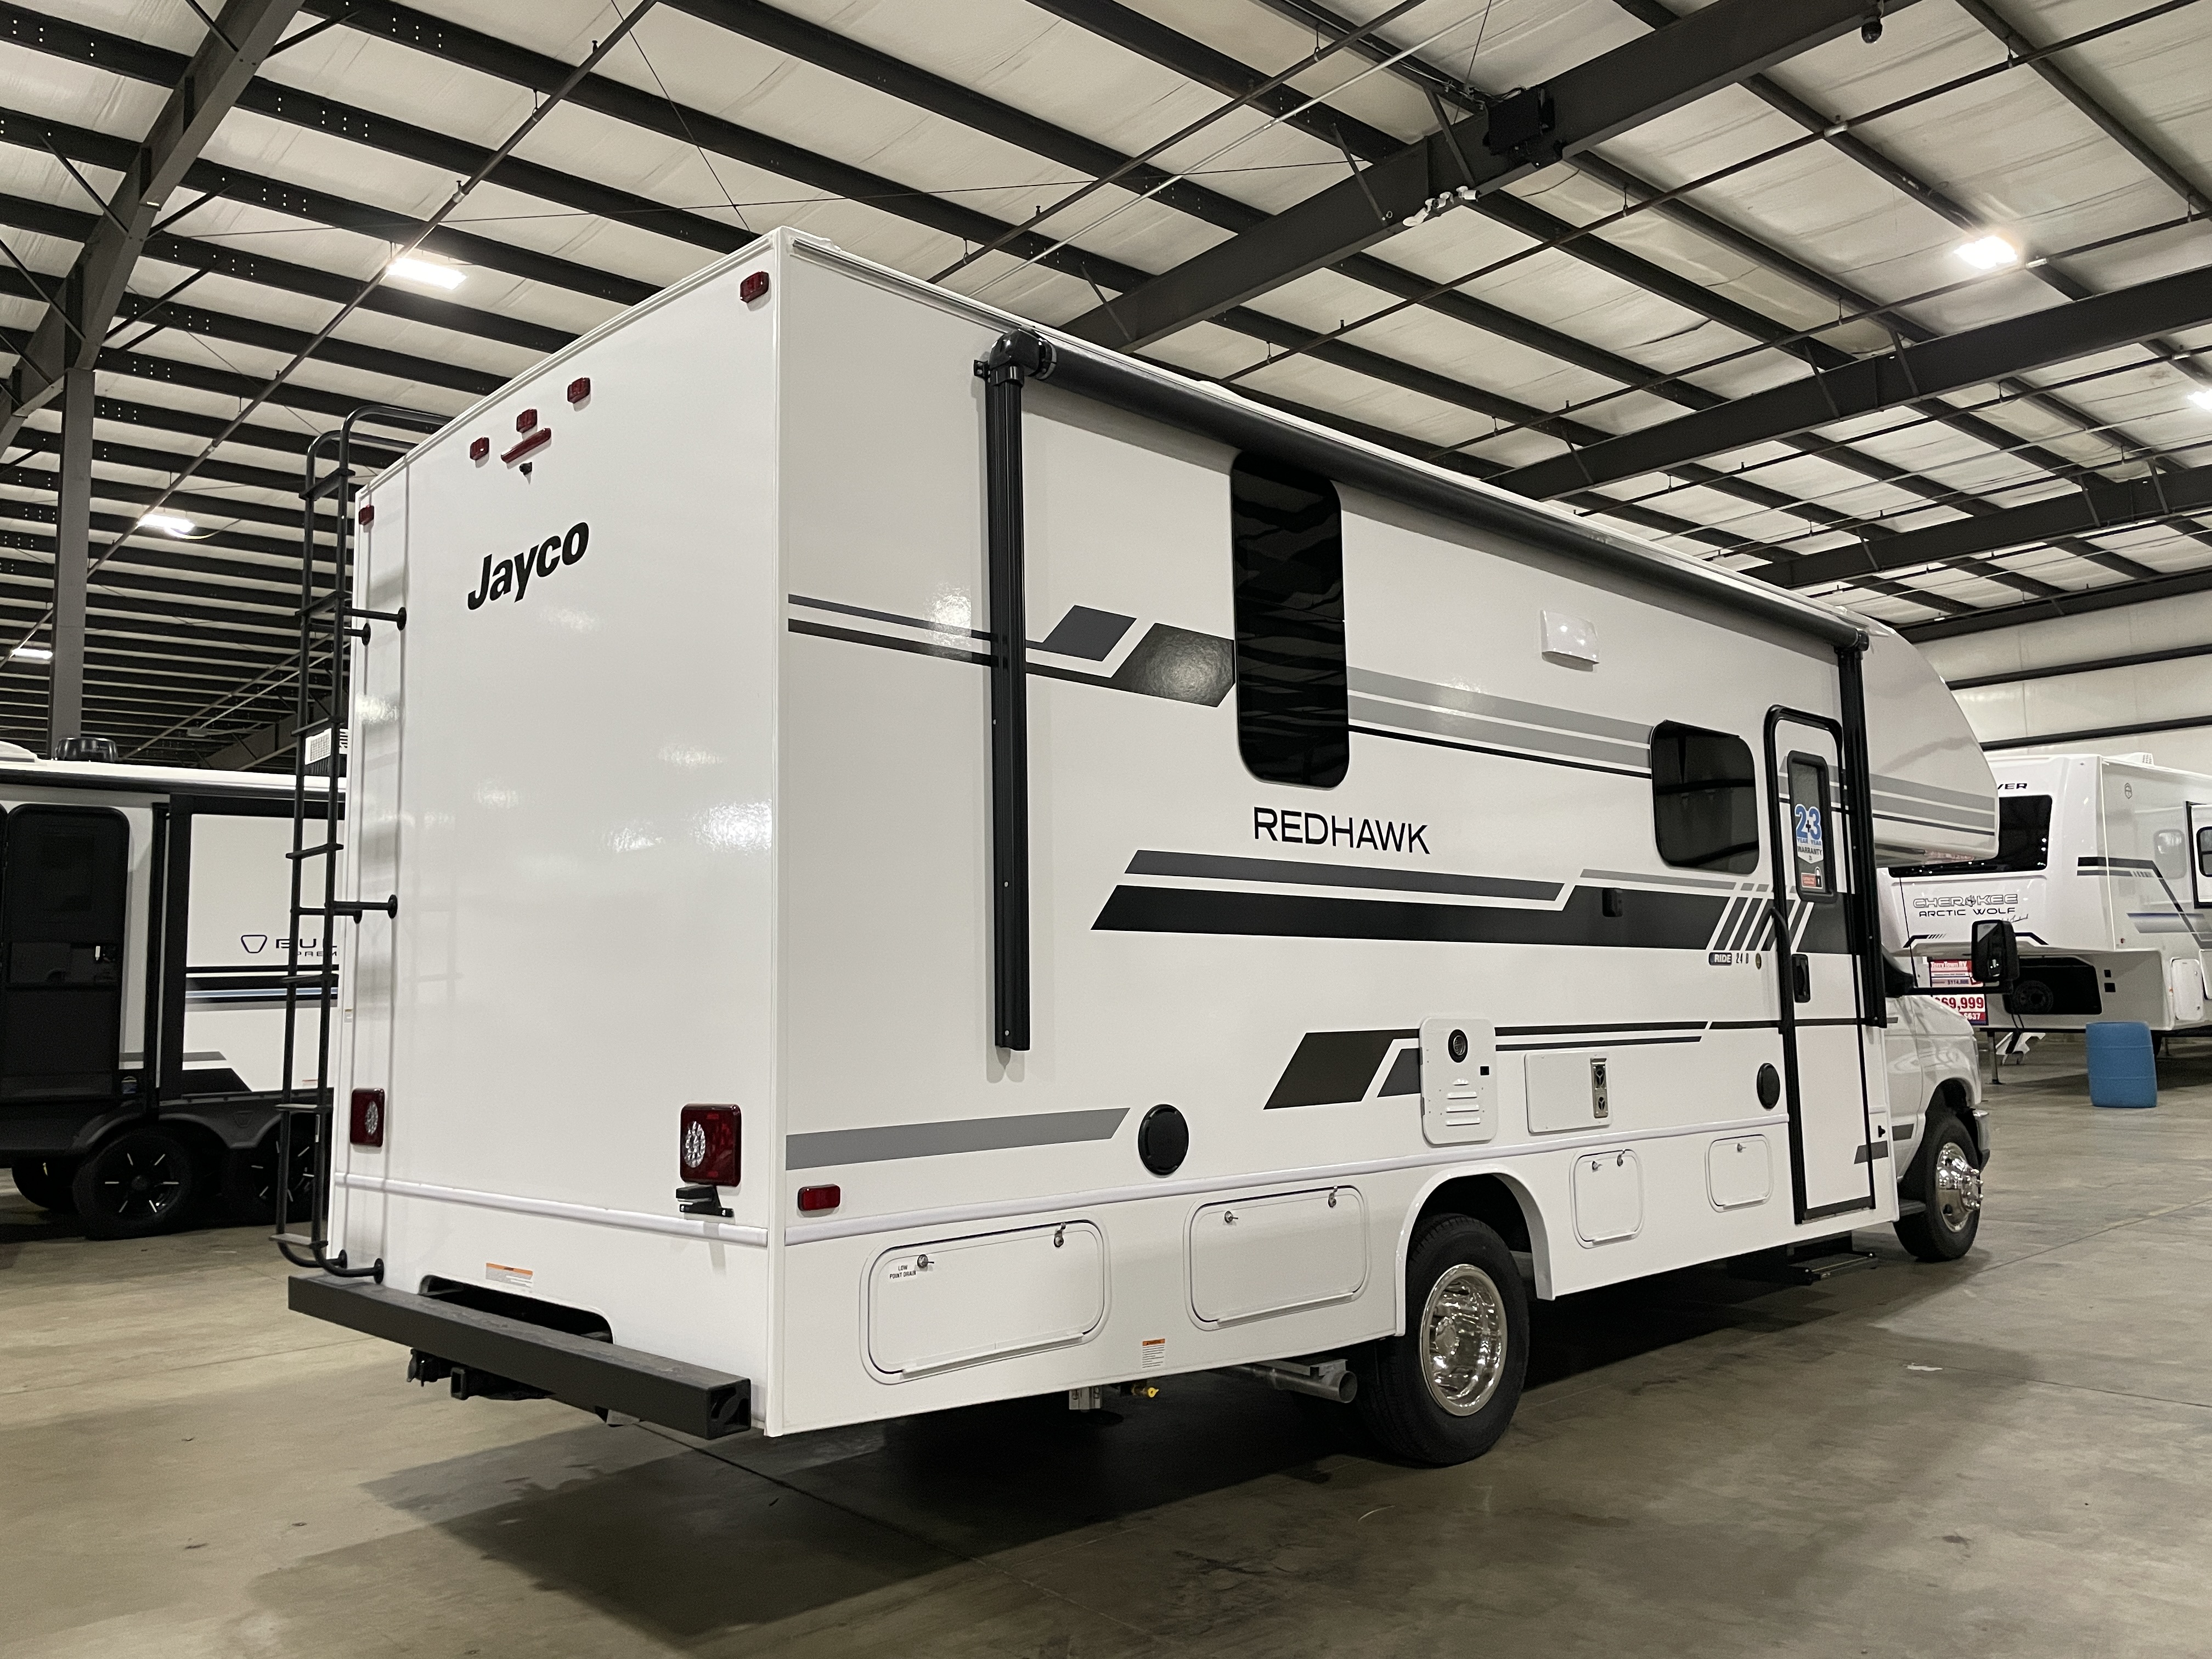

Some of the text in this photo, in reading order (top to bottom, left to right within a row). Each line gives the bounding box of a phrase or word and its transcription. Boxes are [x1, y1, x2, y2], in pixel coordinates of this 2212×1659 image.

[467, 522, 589, 610] Jayco
[1254, 806, 1431, 855] REDHAWK
[1797, 845, 1822, 855] WARRANTY
[1919, 907, 2016, 917] ARCTIC WOLF
[276, 938, 337, 949] BU
